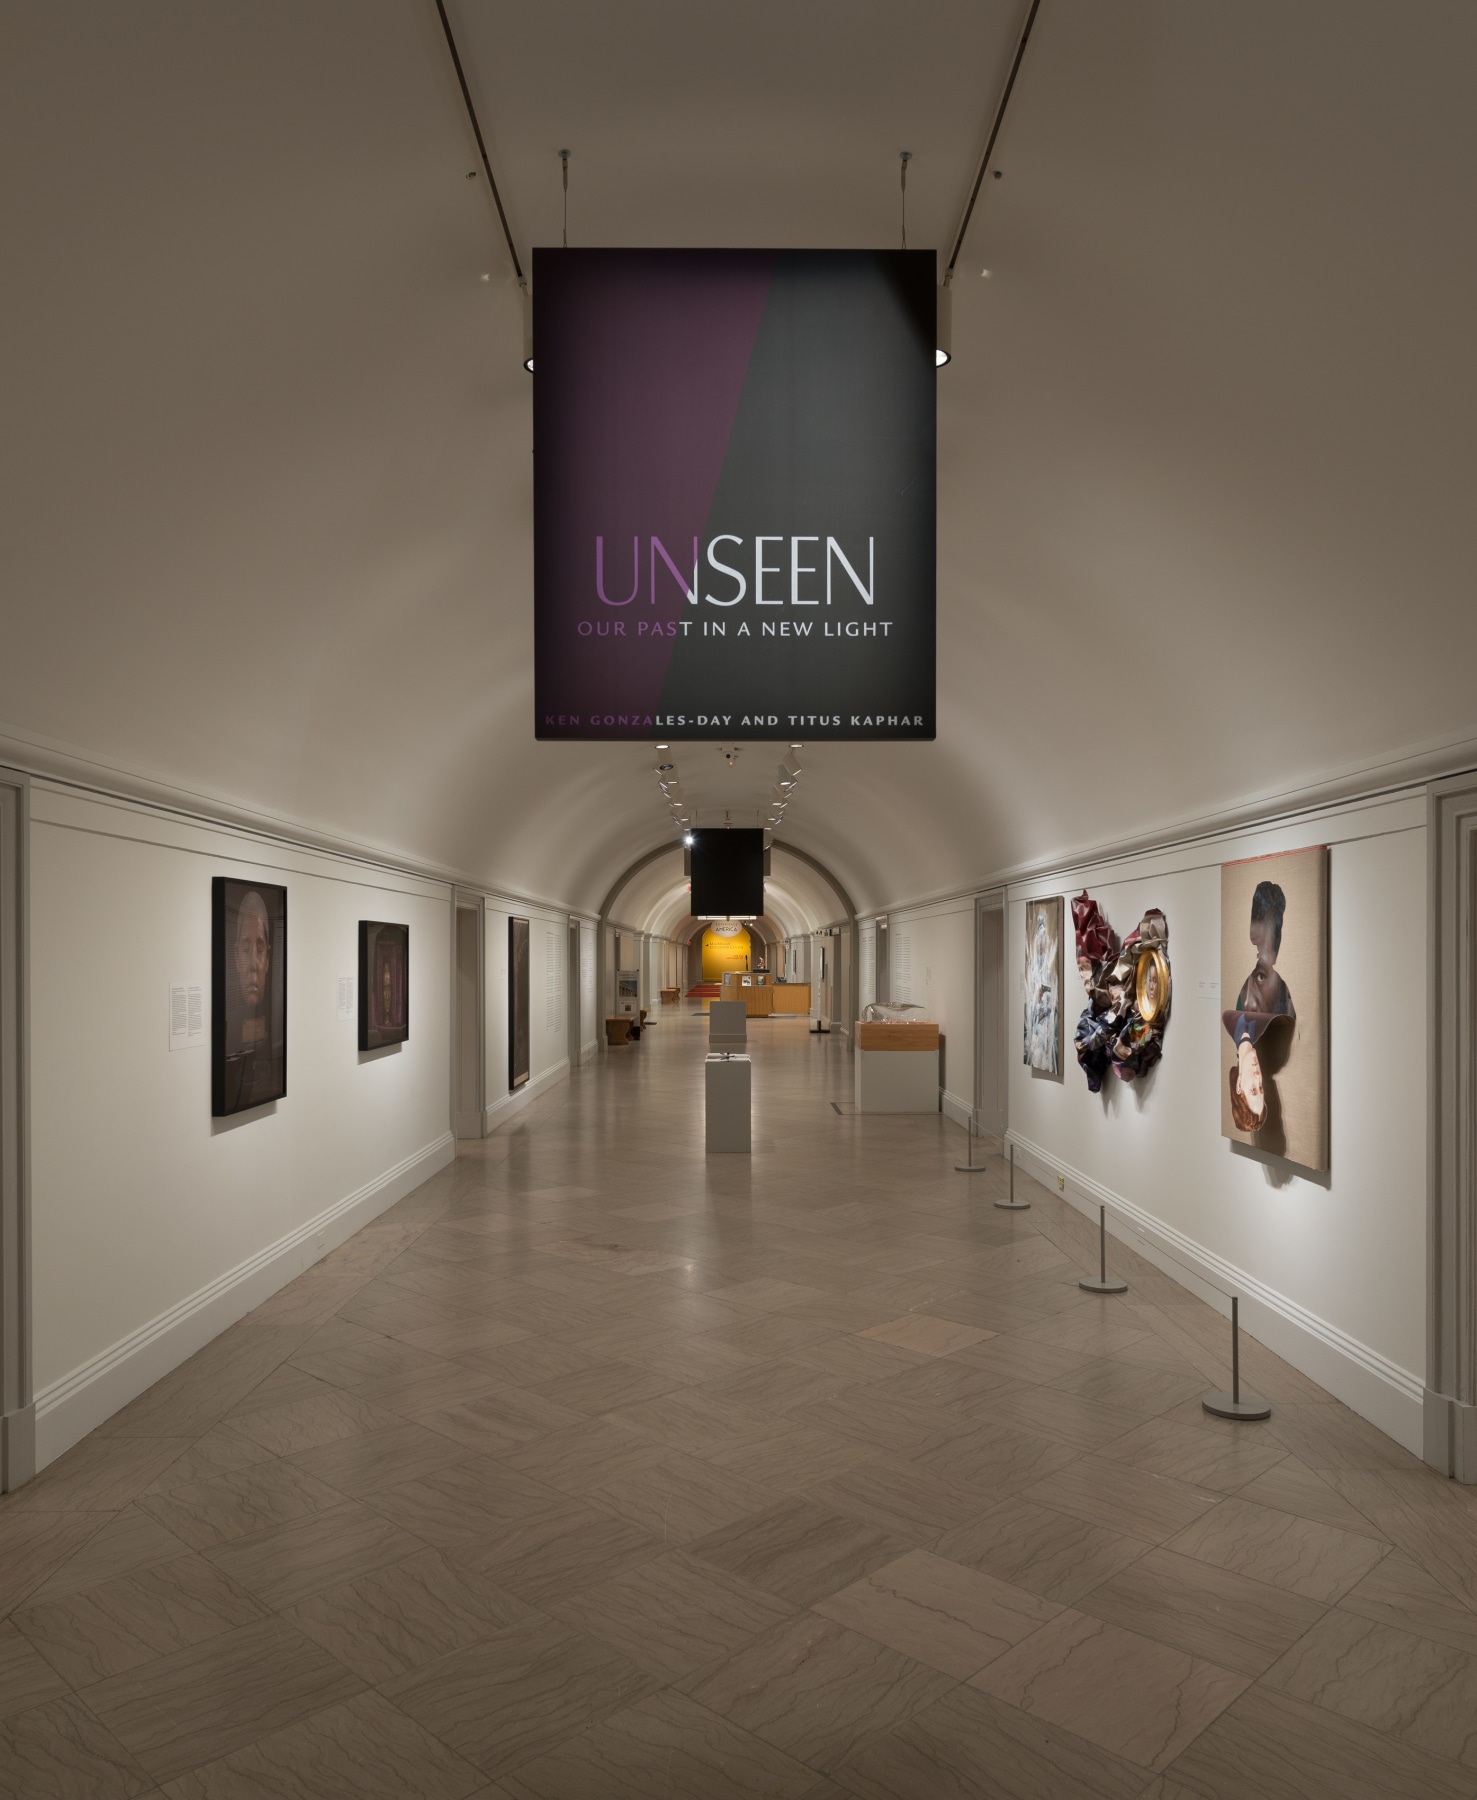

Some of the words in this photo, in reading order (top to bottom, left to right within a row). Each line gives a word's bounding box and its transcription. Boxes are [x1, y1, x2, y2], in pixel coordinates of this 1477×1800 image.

[596, 534, 875, 607] UNSEEN
[577, 621, 627, 637] OUR
[637, 621, 693, 637] PAST
[703, 621, 726, 637] IN
[737, 621, 751, 637] A
[762, 621, 814, 637] NEW
[824, 621, 893, 637] LIGHT
[545, 715, 580, 726] KEN
[590, 715, 732, 726] GONZALES-DAY
[741, 715, 779, 726] AND
[787, 715, 841, 726] TITUS
[850, 715, 924, 726] KAPHAR
